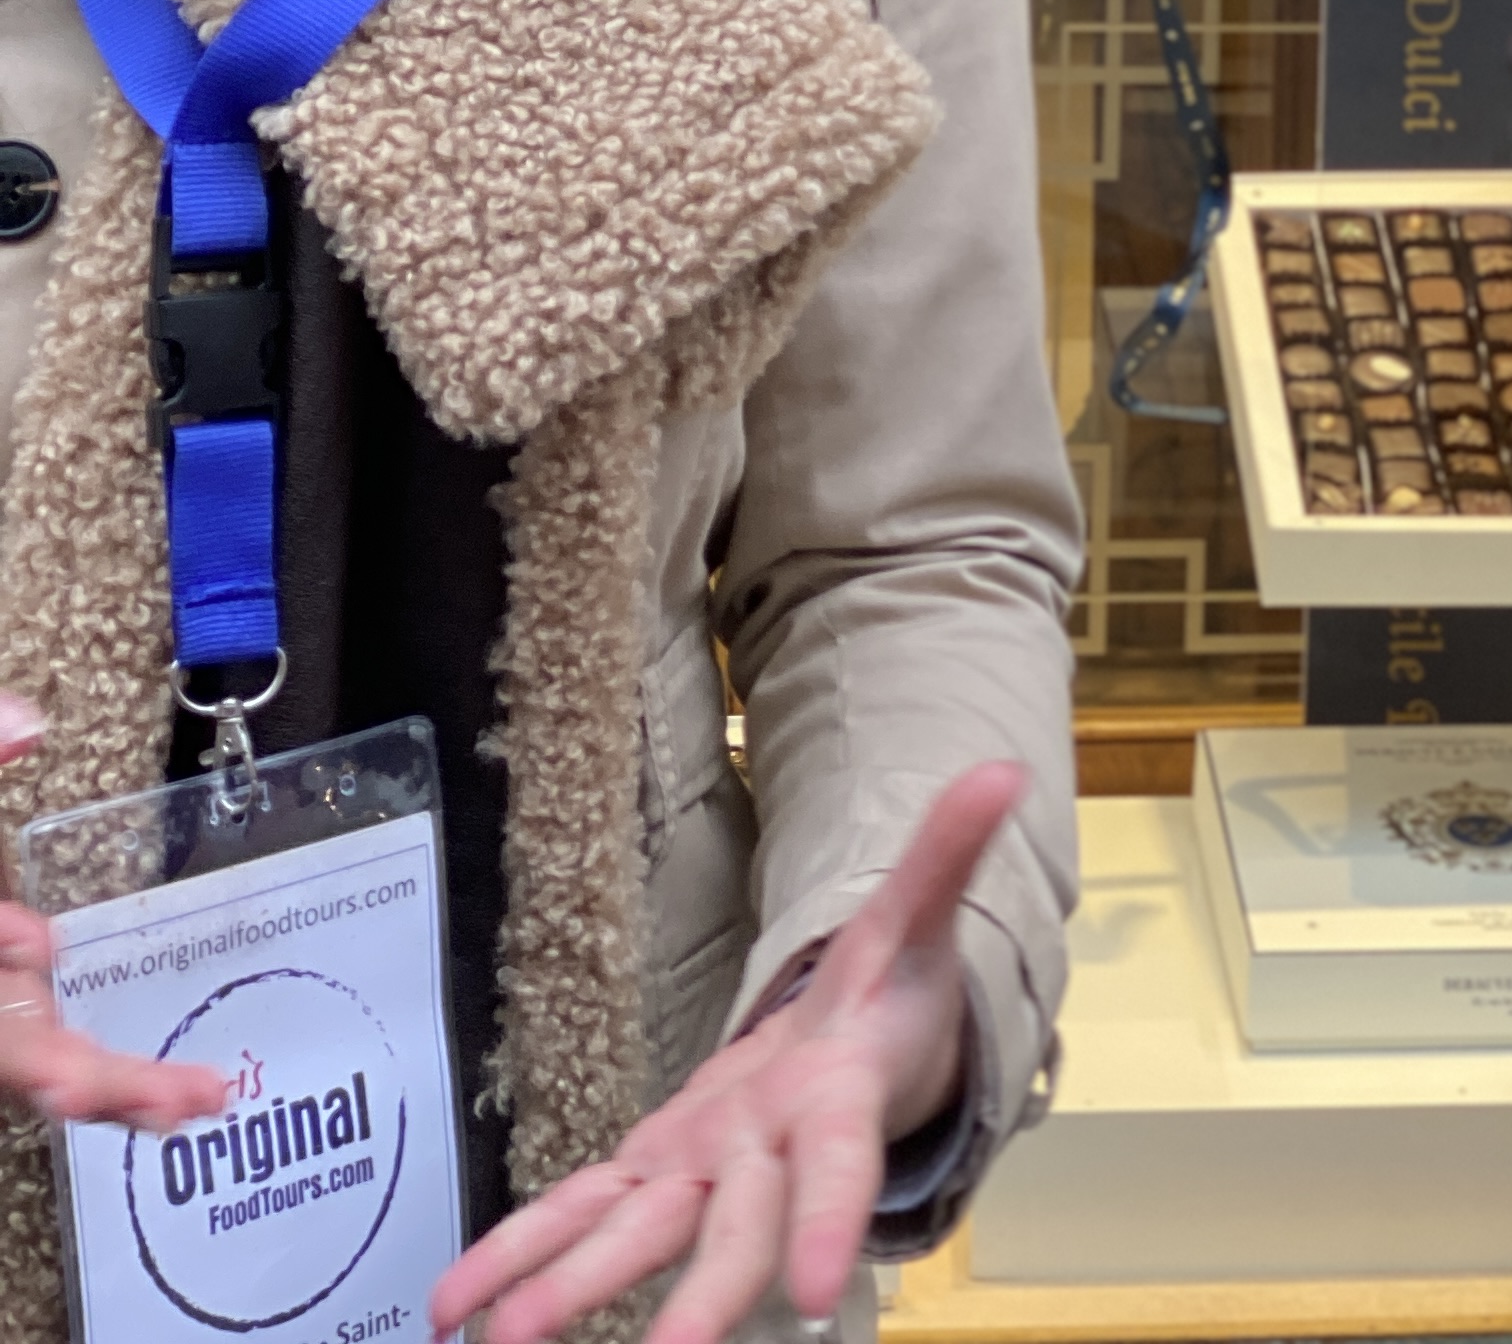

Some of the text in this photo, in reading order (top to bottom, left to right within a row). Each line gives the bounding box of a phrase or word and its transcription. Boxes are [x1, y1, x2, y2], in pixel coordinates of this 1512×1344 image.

[61, 874, 417, 999] www.originalfoodtours.com
[162, 1071, 371, 1206] Original
[208, 1154, 375, 1235] FoodTours.com
[337, 1305, 410, 1344] Saint-
